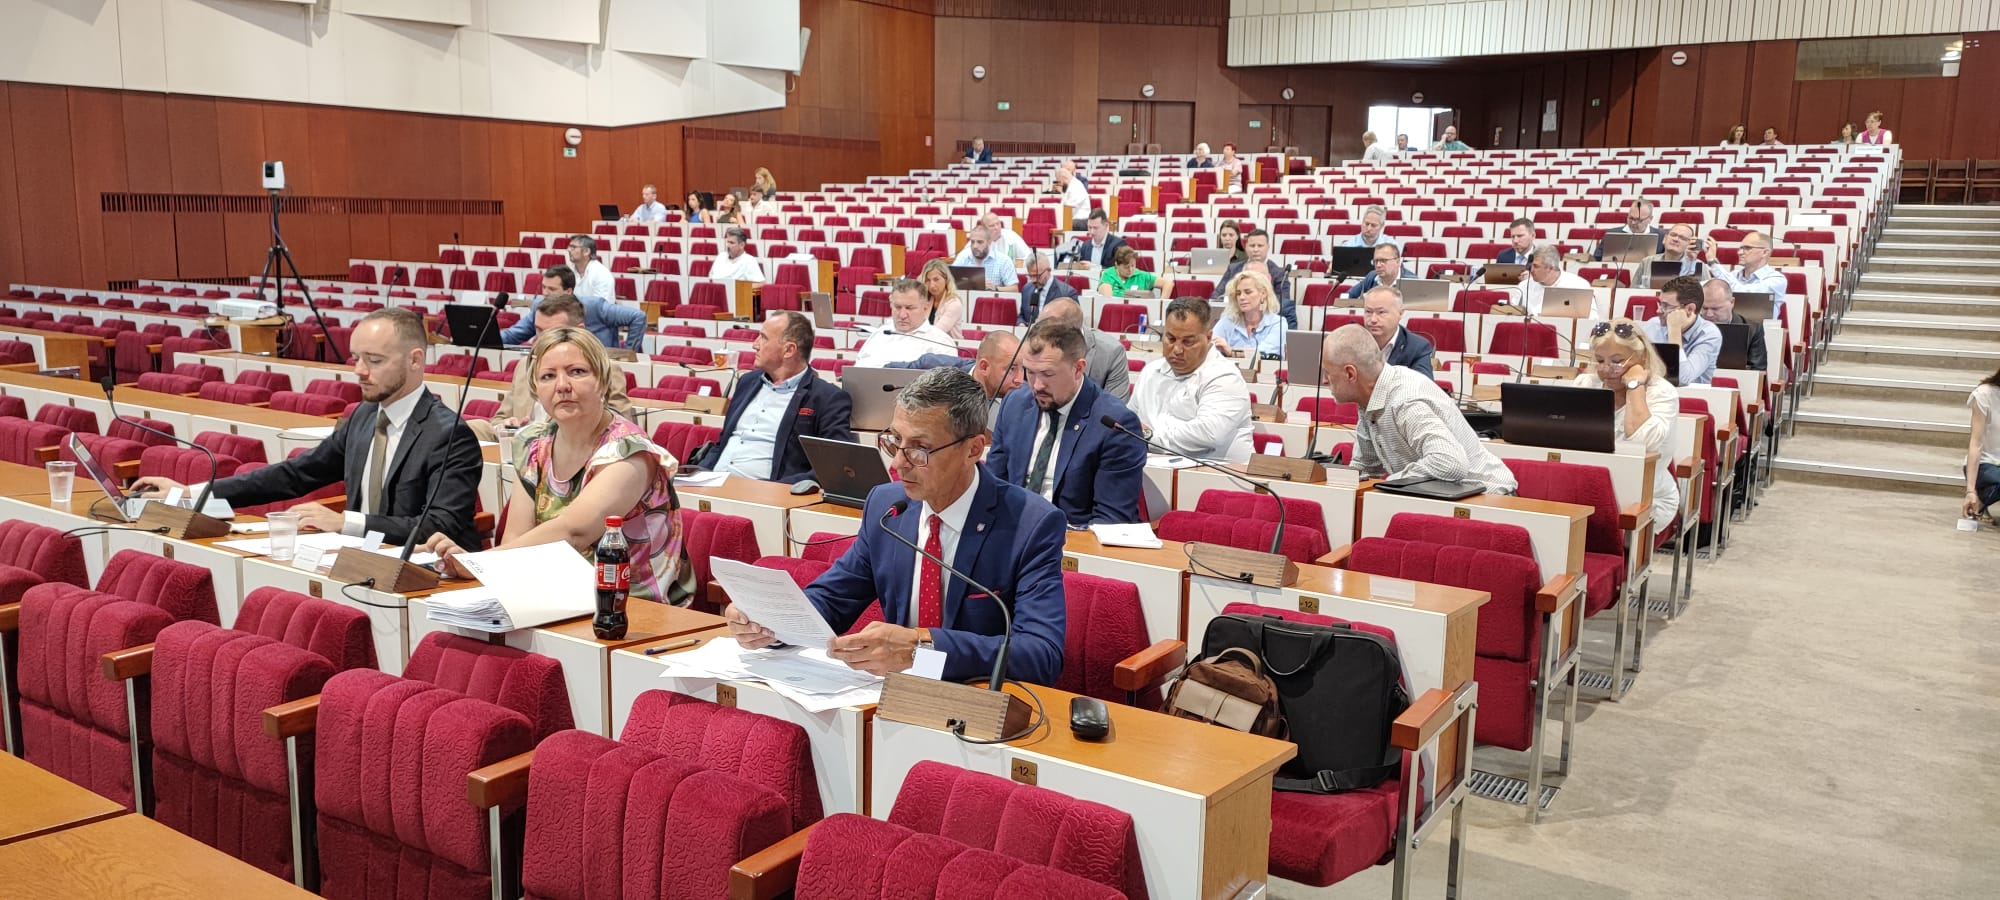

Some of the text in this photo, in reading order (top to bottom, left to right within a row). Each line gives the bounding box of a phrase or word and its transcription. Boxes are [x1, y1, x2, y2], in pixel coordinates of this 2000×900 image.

[1304, 601, 1313, 609] 12
[723, 690, 730, 700] 11
[1019, 766, 1029, 777] 12
